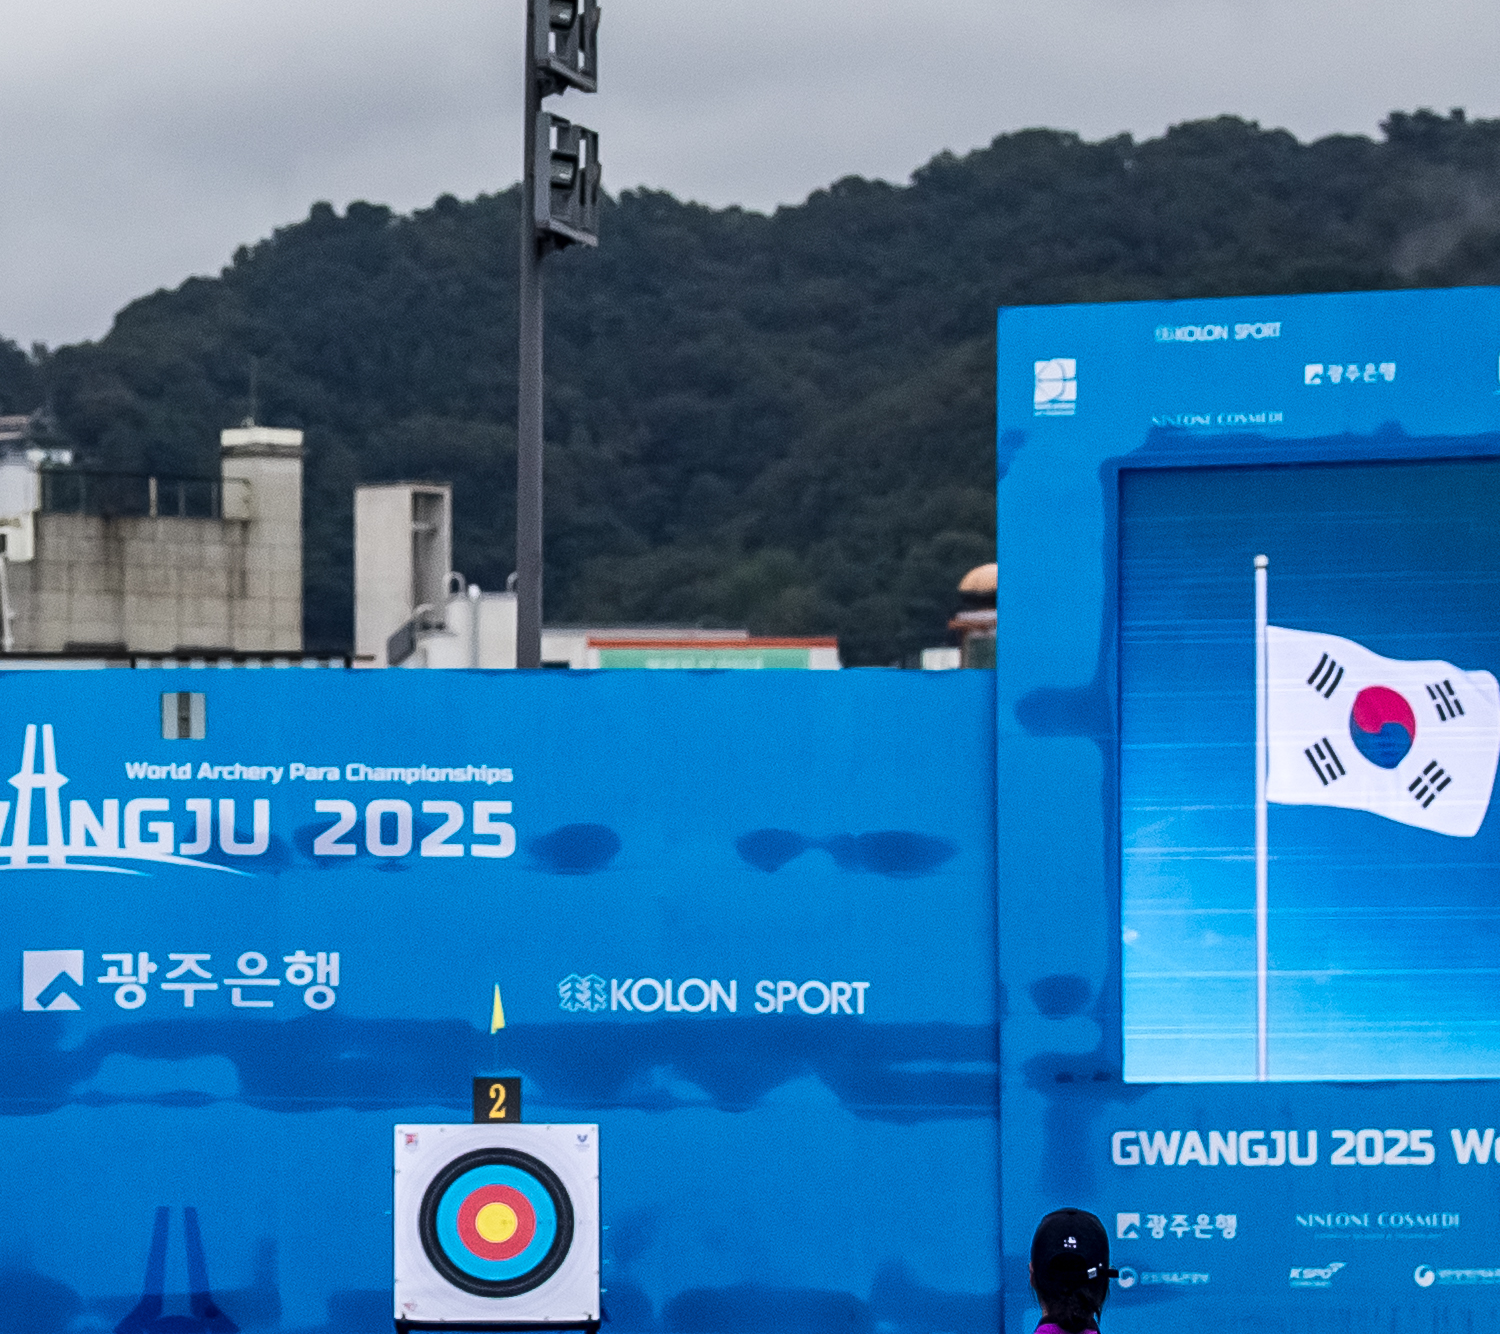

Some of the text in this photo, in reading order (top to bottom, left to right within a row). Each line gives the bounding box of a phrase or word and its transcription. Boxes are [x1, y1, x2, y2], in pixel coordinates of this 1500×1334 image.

[125, 761, 514, 786] World Archery Para Championships
[313, 798, 517, 859] 2025
[97, 950, 341, 1010] 광주은행
[610, 977, 870, 1015] KOLON SPORT
[488, 1083, 507, 1119] 2
[1111, 1128, 1319, 1167] GWANGJU
[1330, 1127, 1437, 1167] 2025
[1145, 1212, 1238, 1240] 광주은행
